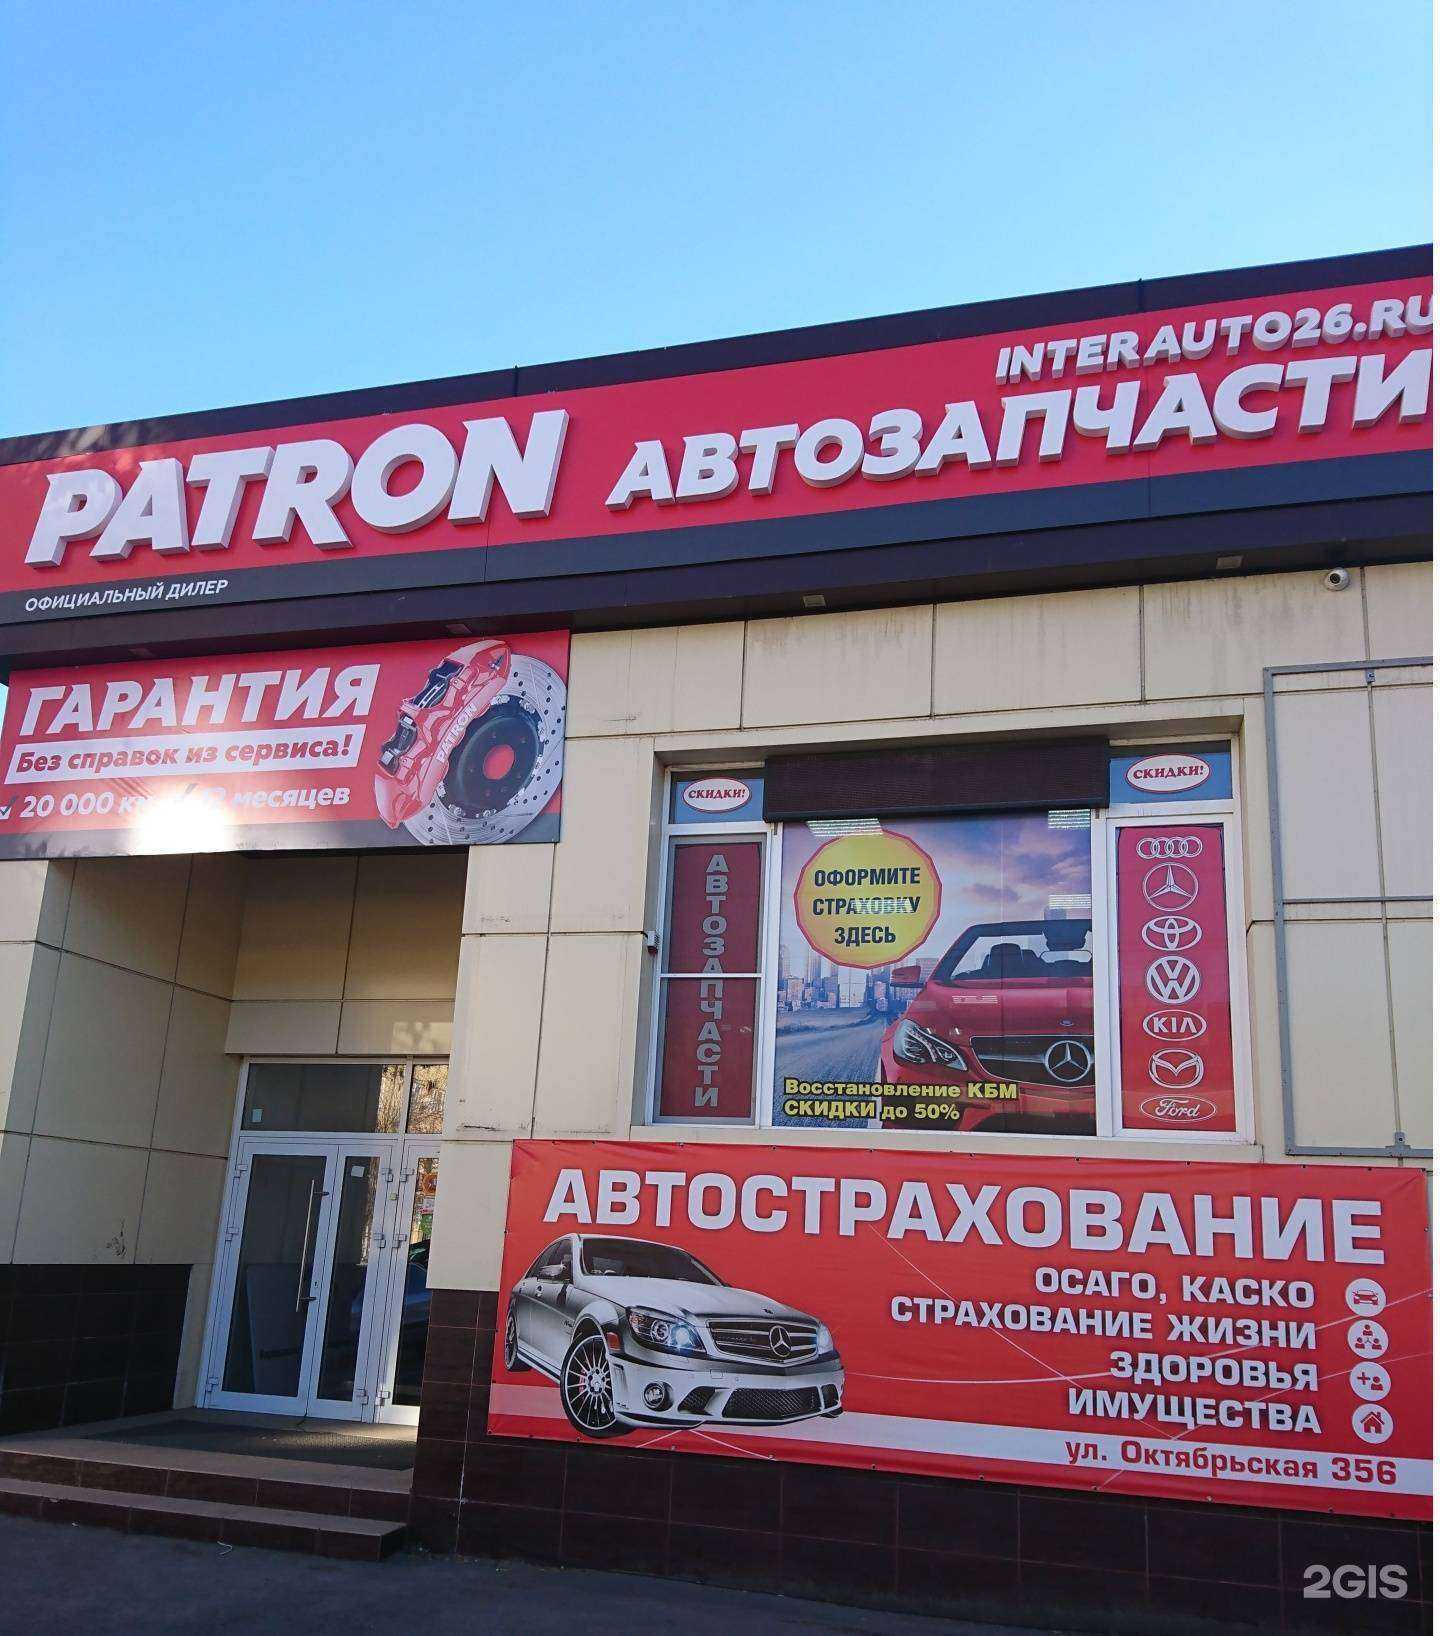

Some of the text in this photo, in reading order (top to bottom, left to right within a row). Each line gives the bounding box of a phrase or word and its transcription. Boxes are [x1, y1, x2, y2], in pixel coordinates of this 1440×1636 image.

[605, 348, 1433, 512] АВТОЗАПЧАСТИ
[24, 409, 570, 568] PATRON
[25, 579, 229, 611] ОФИЦИАЛЬНЫЙ ДИЛЕР
[19, 663, 381, 737] ГАРАНТИЯ
[15, 732, 354, 775] Без справок из сервиса!
[1132, 764, 1204, 780] СКИДКИ!
[19, 795, 55, 818] 20
[59, 790, 114, 816] 000
[233, 786, 350, 810] месяцев
[688, 788, 746, 800] СКИДКИ!
[813, 866, 922, 888] ОФОРМИТЕ
[812, 896, 922, 916] СТРАХОВКУ
[834, 925, 897, 948] ЗДЕСЬ
[694, 854, 730, 1108] АВТОЗАПЧАСТИ
[1153, 1016, 1199, 1034] KIA
[784, 1078, 1018, 1100] Восстановление КБМ
[783, 1099, 961, 1121] СКИДКИ до 50%
[1154, 1098, 1200, 1119] Ford
[542, 1168, 1386, 1265] АВТОСТРАХОВАНИЕ
[1034, 1267, 1315, 1309] ОСАГО, КАСКО
[890, 1296, 1317, 1350] СТРАХОВАНИЕ ЖИЗНИ
[1109, 1351, 1319, 1392] ЗДОРОВЬЯ
[1067, 1387, 1323, 1435] ИМУЩЕСТВА
[1064, 1440, 1398, 1485] ул. Октябрьская 356
